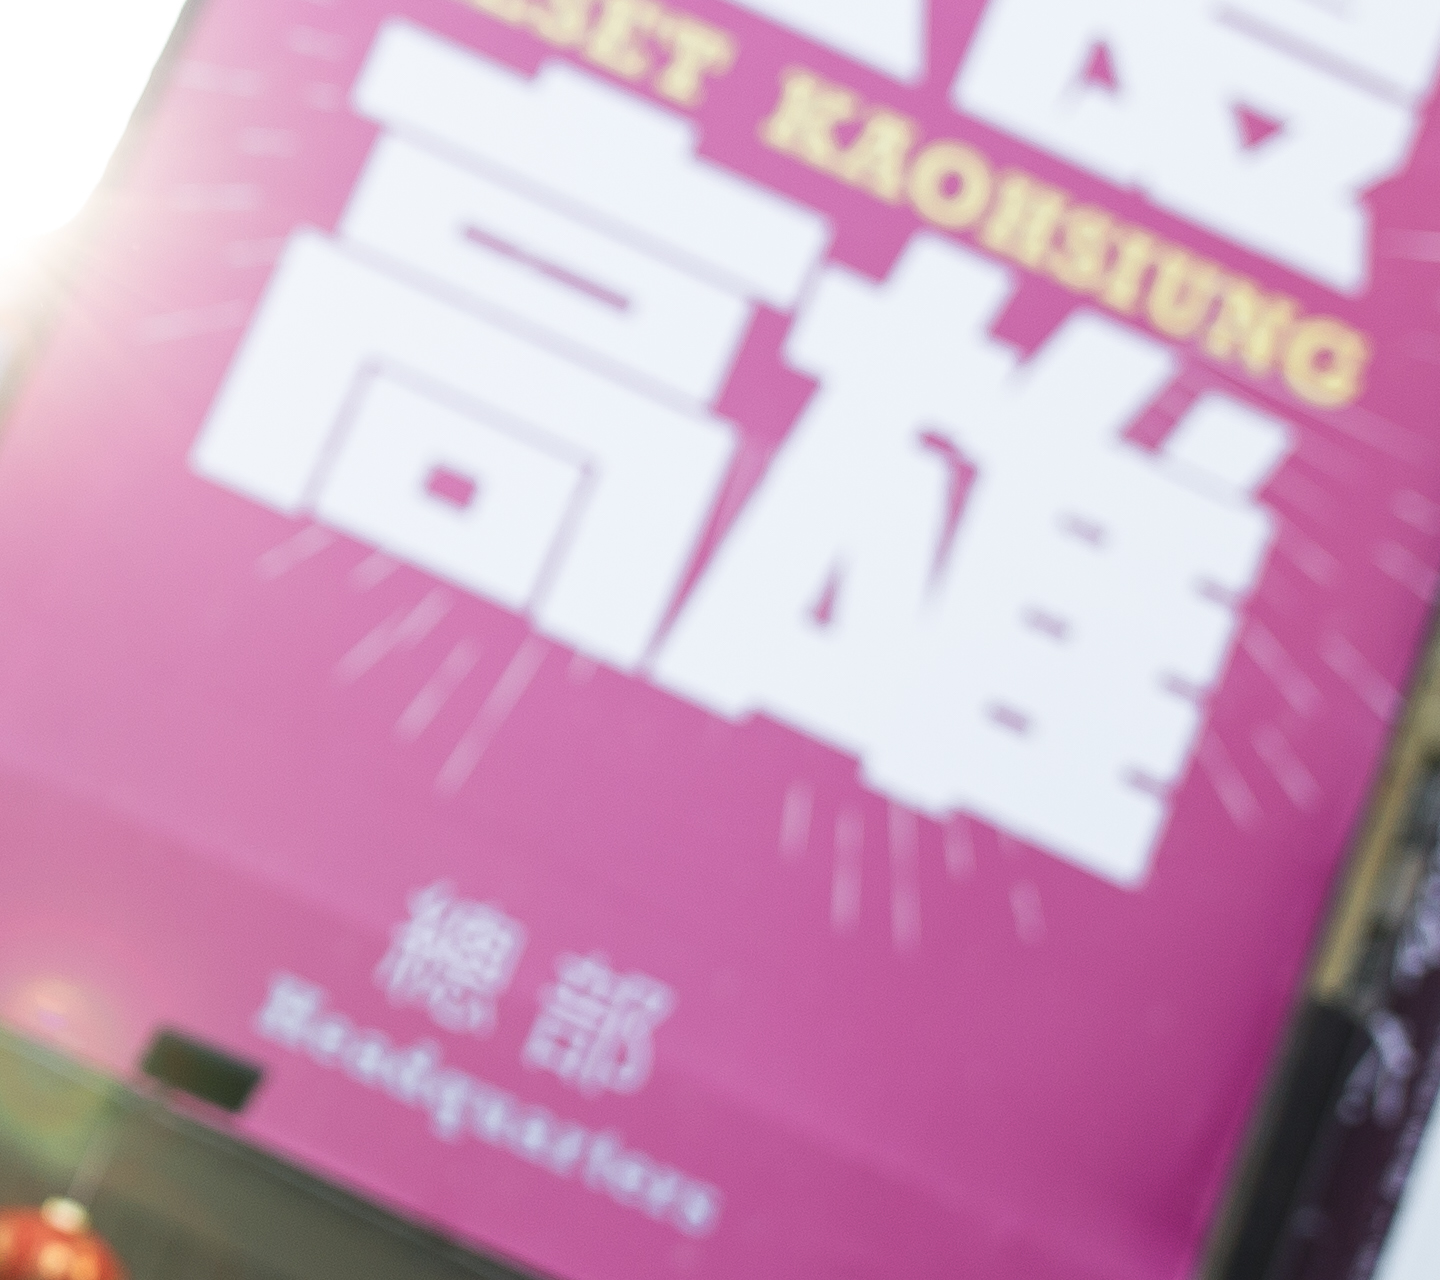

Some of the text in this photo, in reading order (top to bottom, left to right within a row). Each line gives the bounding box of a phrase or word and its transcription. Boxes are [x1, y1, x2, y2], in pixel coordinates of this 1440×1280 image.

[761, 62, 1378, 412] KAOHSIUNG
[188, 18, 1298, 891] 高雄
[255, 974, 726, 1243] Headquarters
[379, 880, 674, 1093] 總部
